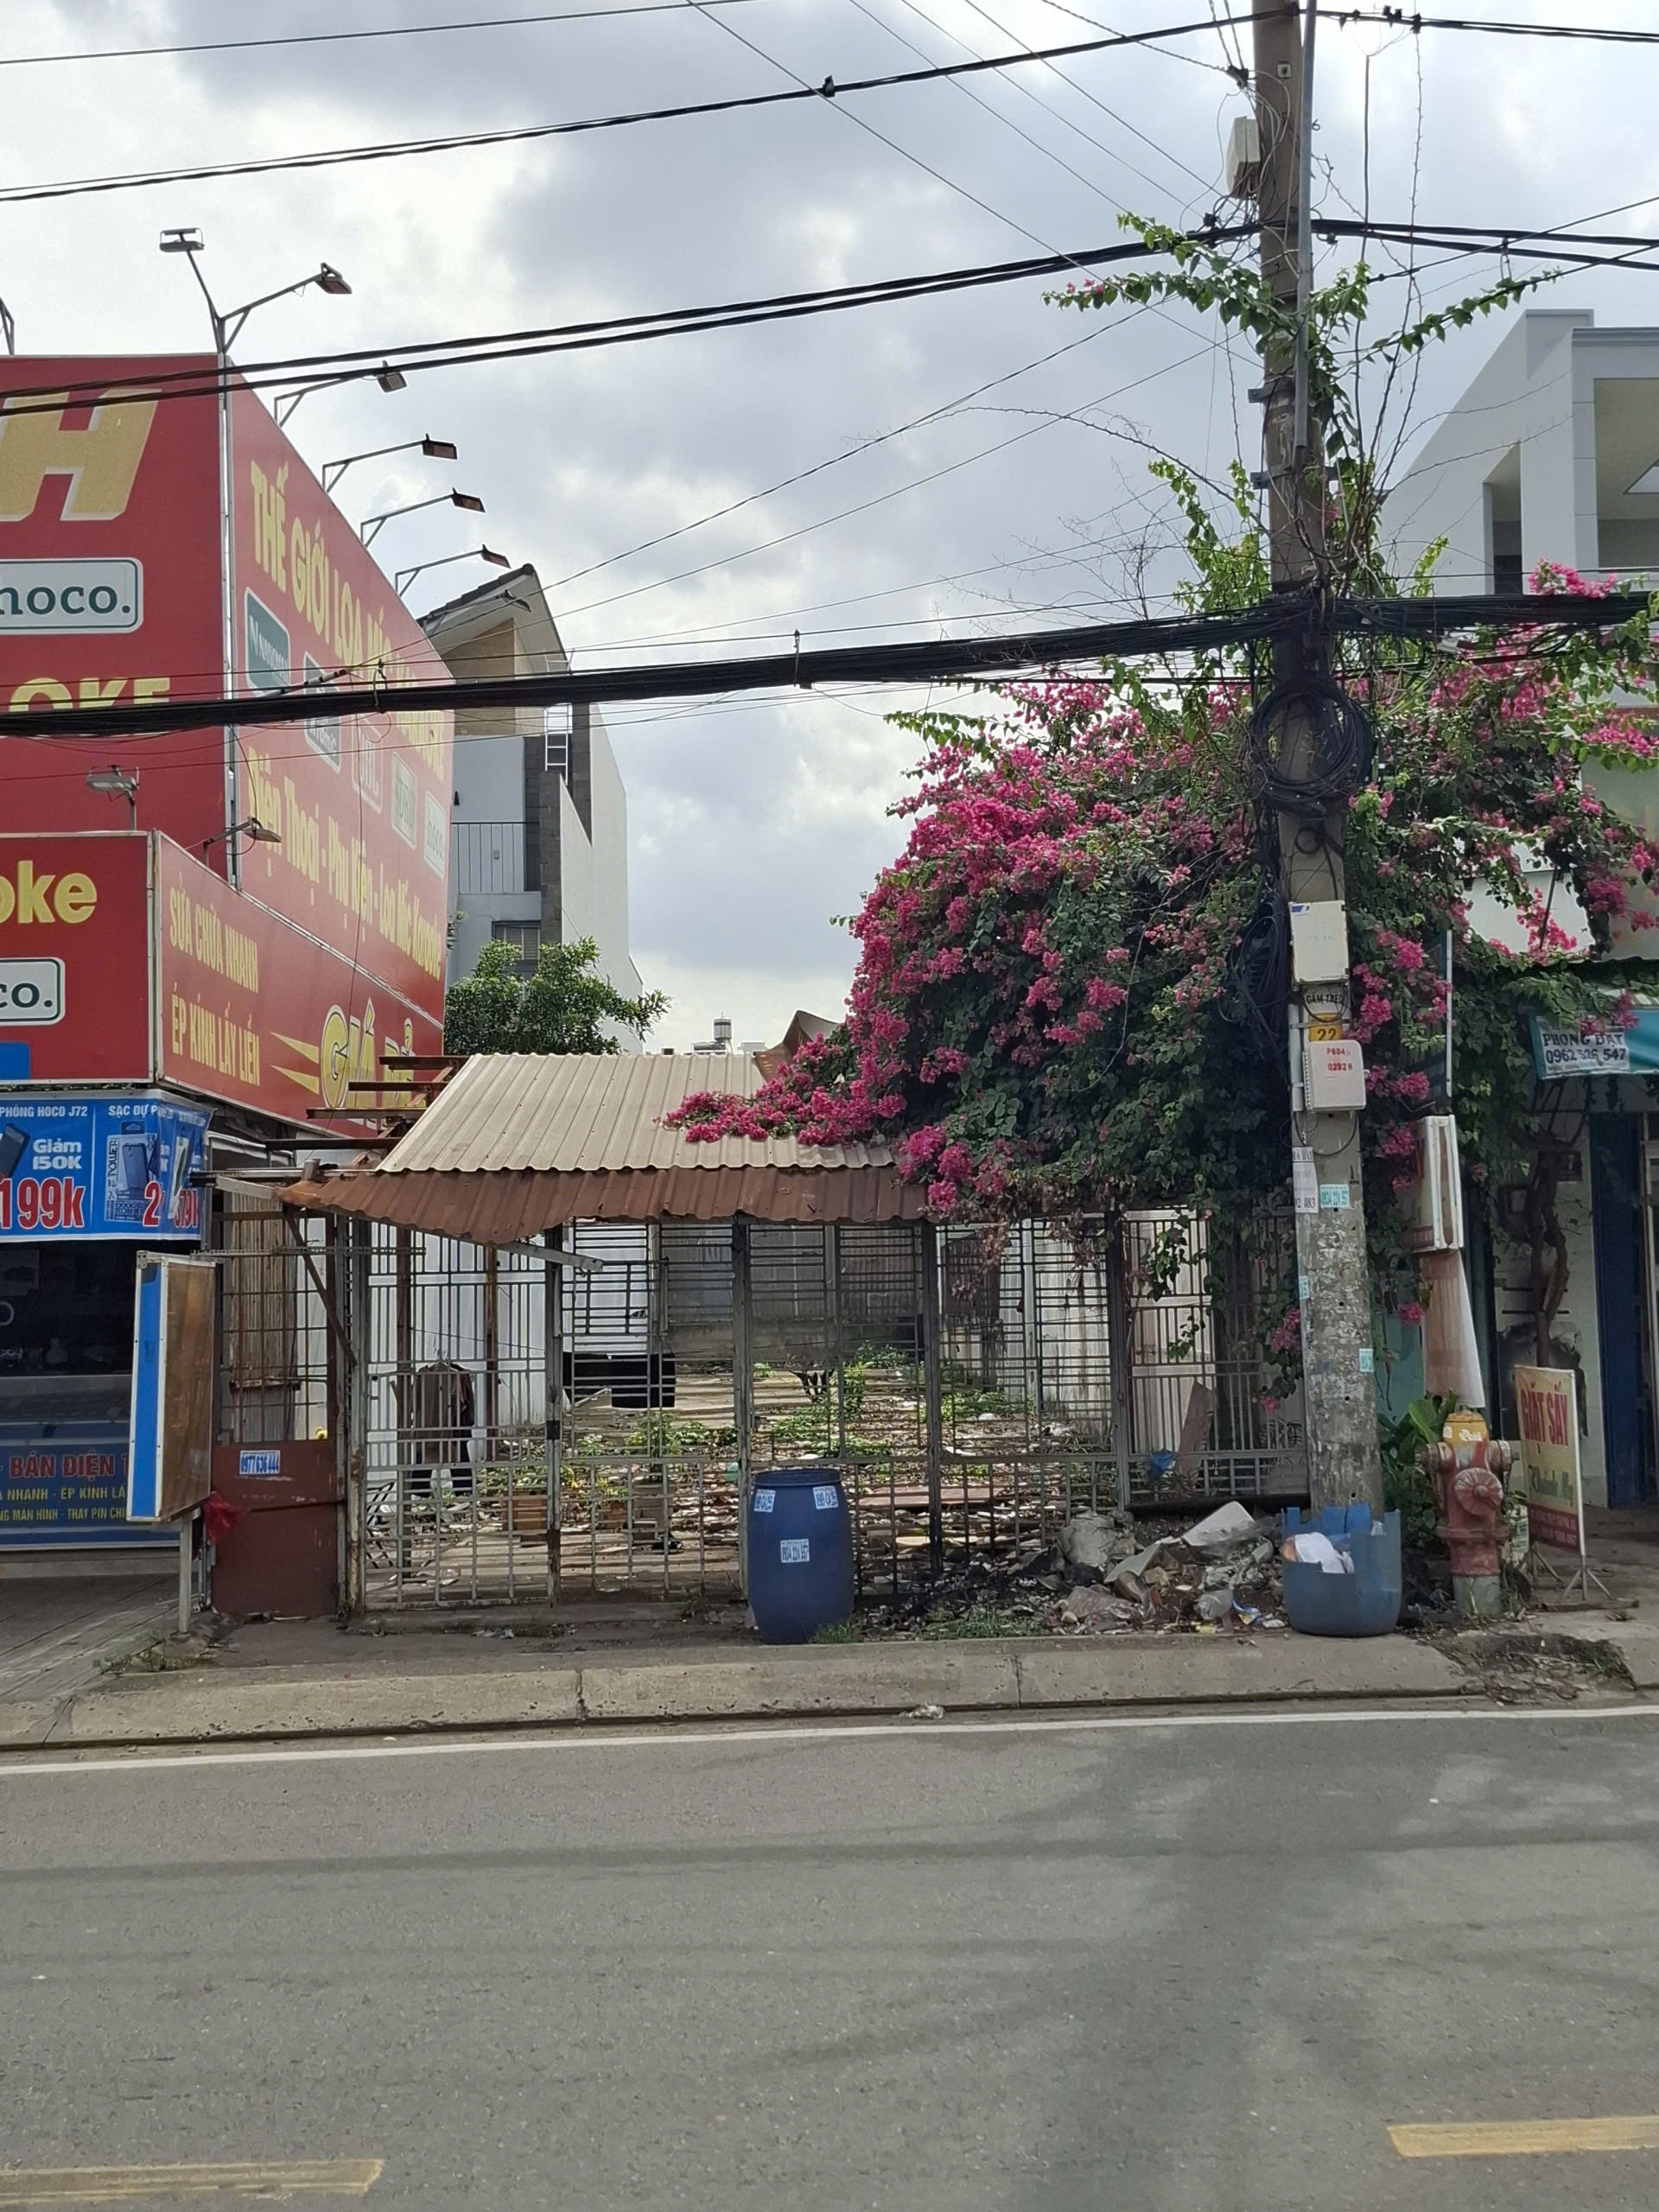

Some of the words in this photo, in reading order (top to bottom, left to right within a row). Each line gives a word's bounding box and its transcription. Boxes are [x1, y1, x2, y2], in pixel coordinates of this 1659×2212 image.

[251, 460, 289, 594] THẾ
[291, 518, 330, 645] GIỚI
[334, 568, 365, 691] LOA
[284, 775, 320, 906] Thoại
[328, 815, 349, 931] Phụ
[169, 871, 193, 956] SỬA
[195, 901, 224, 975] CHỮA
[225, 923, 258, 995] NHANH
[172, 982, 187, 1055] ÉP
[190, 993, 216, 1069] KÍNH
[219, 1001, 237, 1077] LẤY
[1317, 1027, 1338, 1040] 22
[1603, 1048, 1627, 1061] 547
[37, 1106, 66, 1117] HOCO
[68, 1106, 88, 1117] J72
[108, 1105, 131, 1119] SẠC
[133, 1104, 150, 1119] DỰ
[33, 1137, 82, 1154] Giảm
[1546, 1381, 1568, 1446] SẤY
[10, 1451, 57, 1479] BÁN
[62, 1449, 116, 1482] ĐIỆN
[7, 1487, 48, 1501] NHANH
[91, 1507, 107, 1519] PIN
